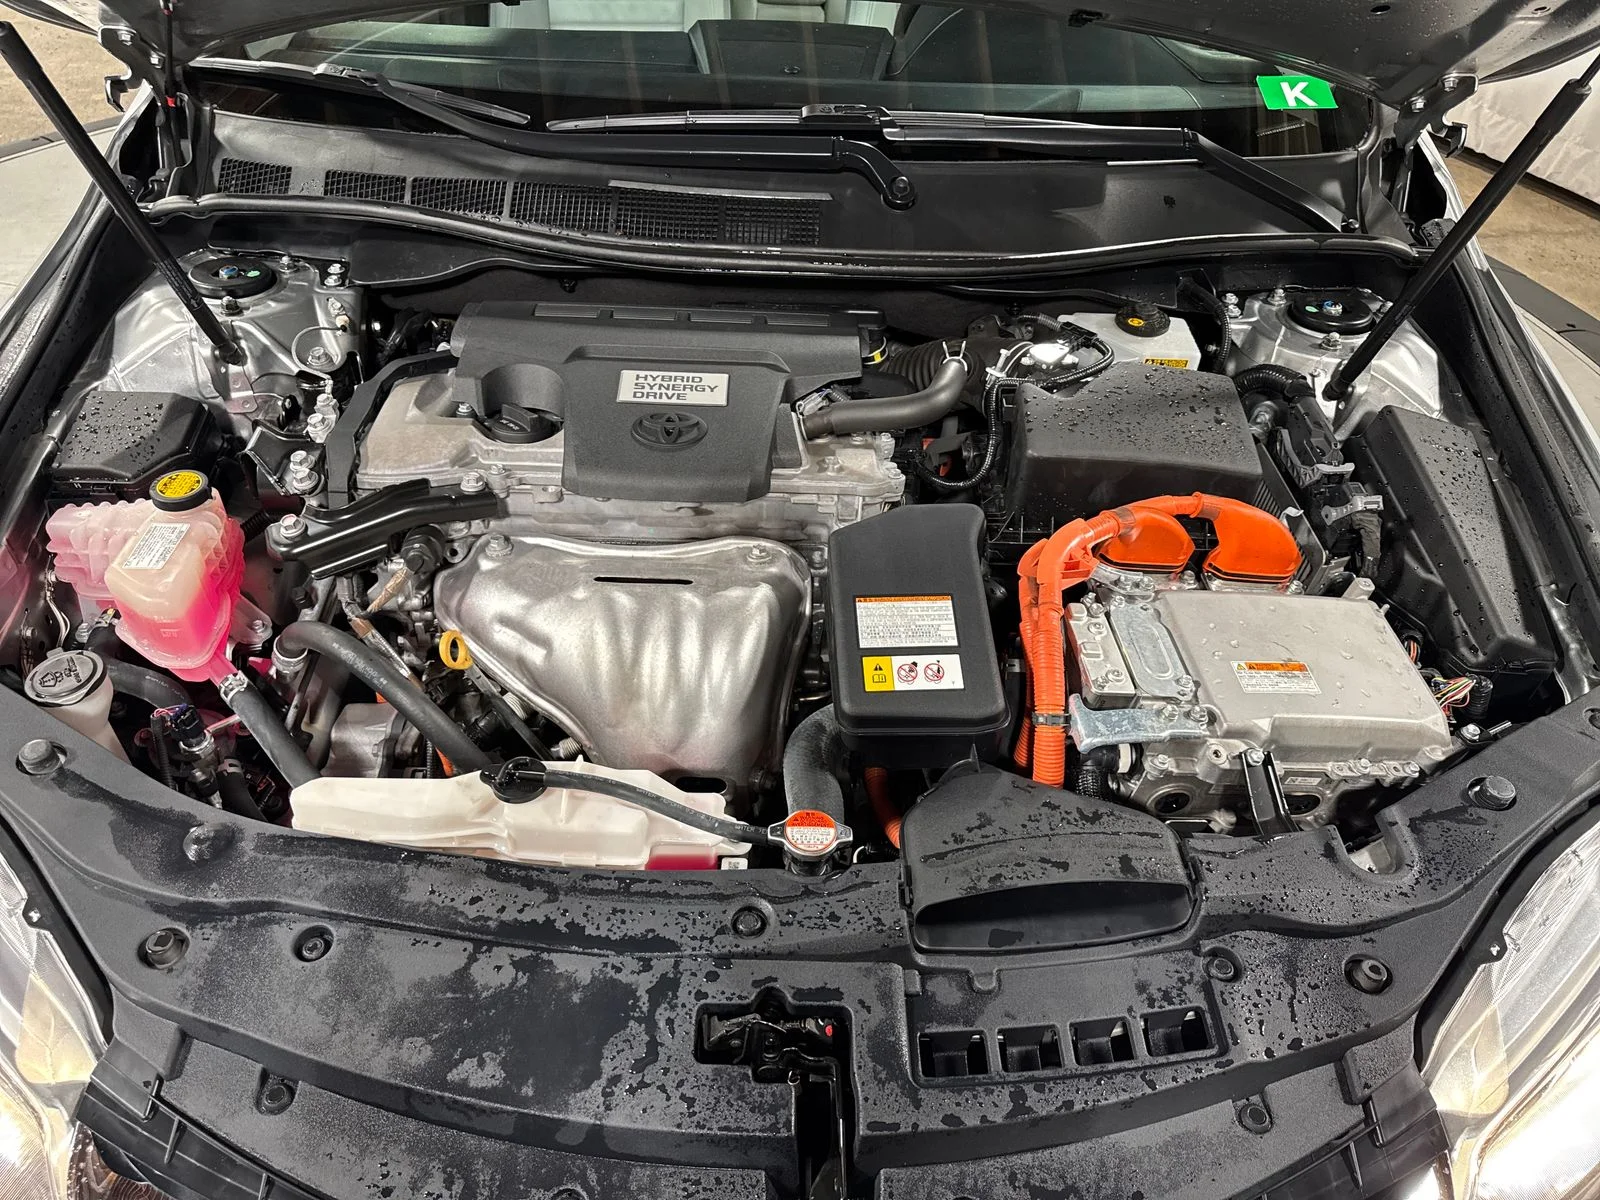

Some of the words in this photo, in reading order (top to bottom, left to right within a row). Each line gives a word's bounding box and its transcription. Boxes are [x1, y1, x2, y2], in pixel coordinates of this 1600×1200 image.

[1279, 81, 1318, 107] K
[635, 374, 703, 384] HYBRID
[633, 382, 719, 393] SYNERGY
[632, 391, 688, 401] DRIVE
